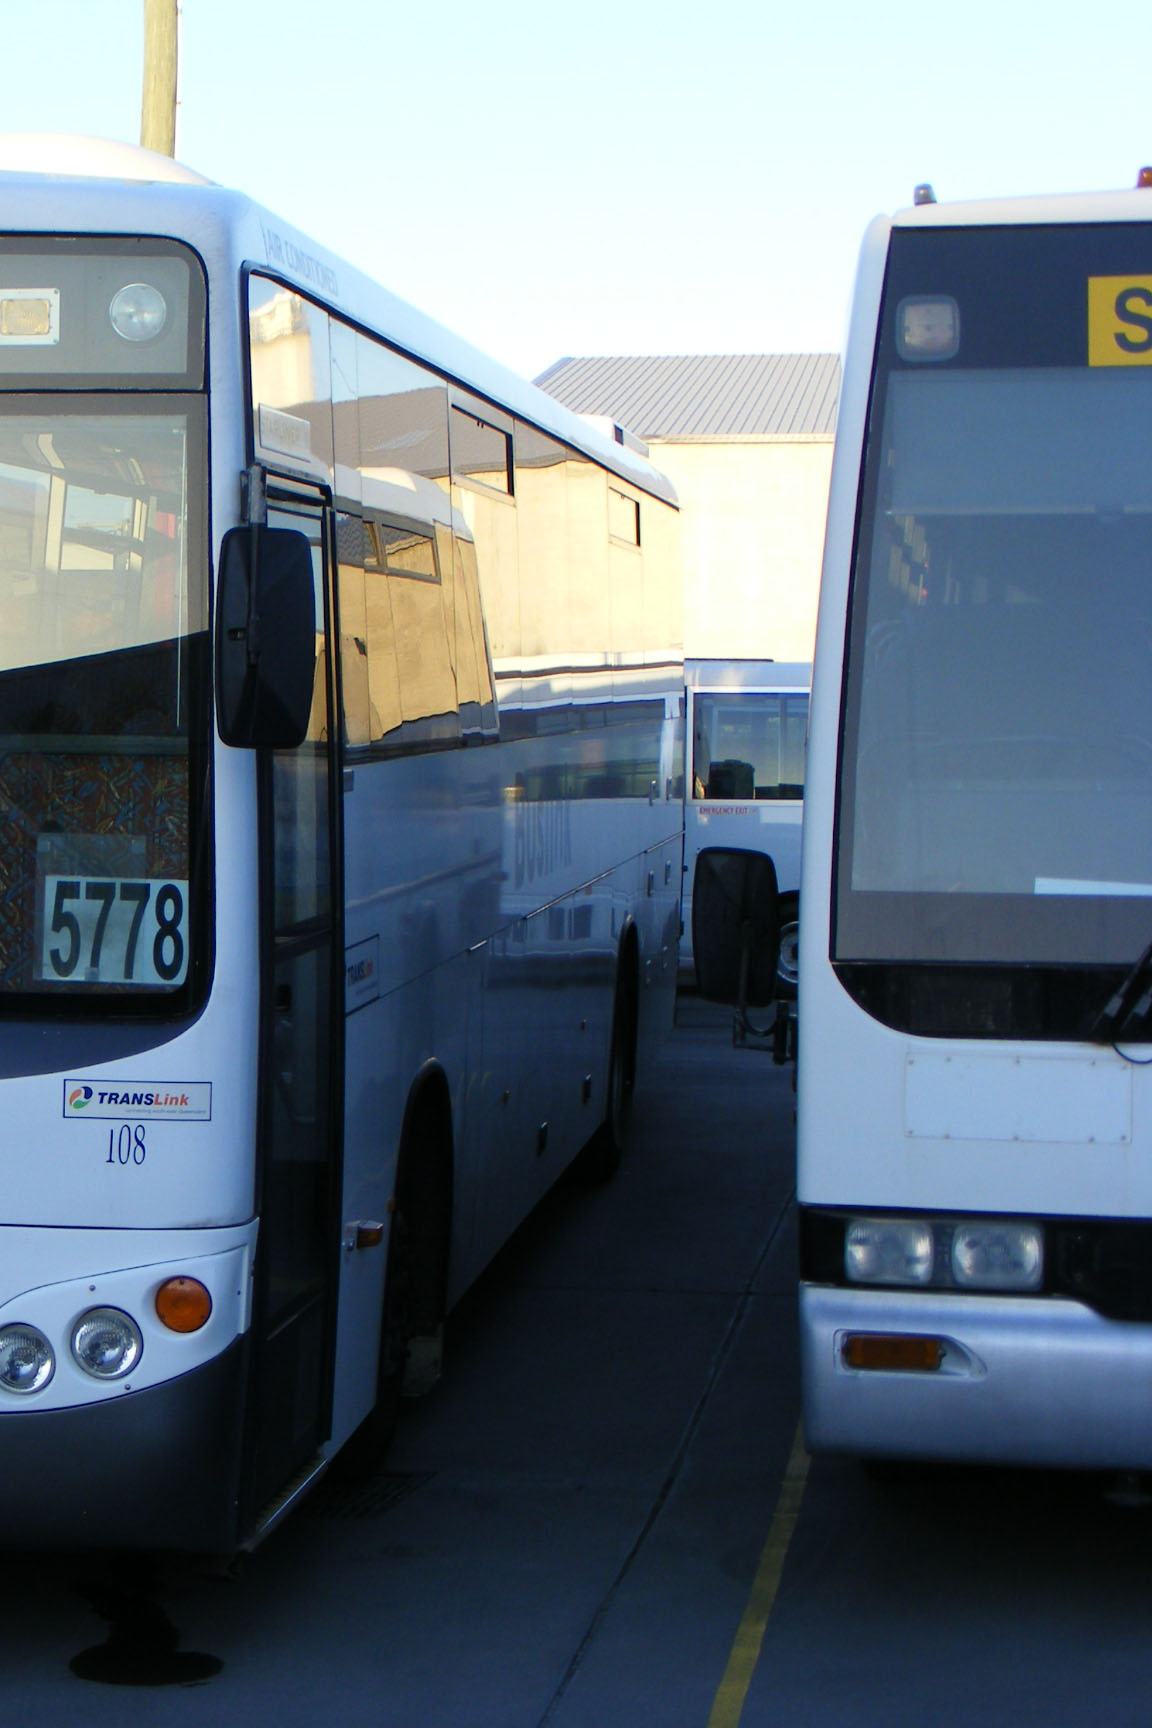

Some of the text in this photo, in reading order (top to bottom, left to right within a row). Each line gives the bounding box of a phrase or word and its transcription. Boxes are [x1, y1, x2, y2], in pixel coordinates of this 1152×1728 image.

[1113, 287, 1152, 353] S
[699, 806, 733, 815] EMERGENCY
[735, 807, 748, 815] EXIT
[49, 881, 184, 981] 5778
[98, 1092, 189, 1107] TRANSLink
[106, 1124, 146, 1166] 108
